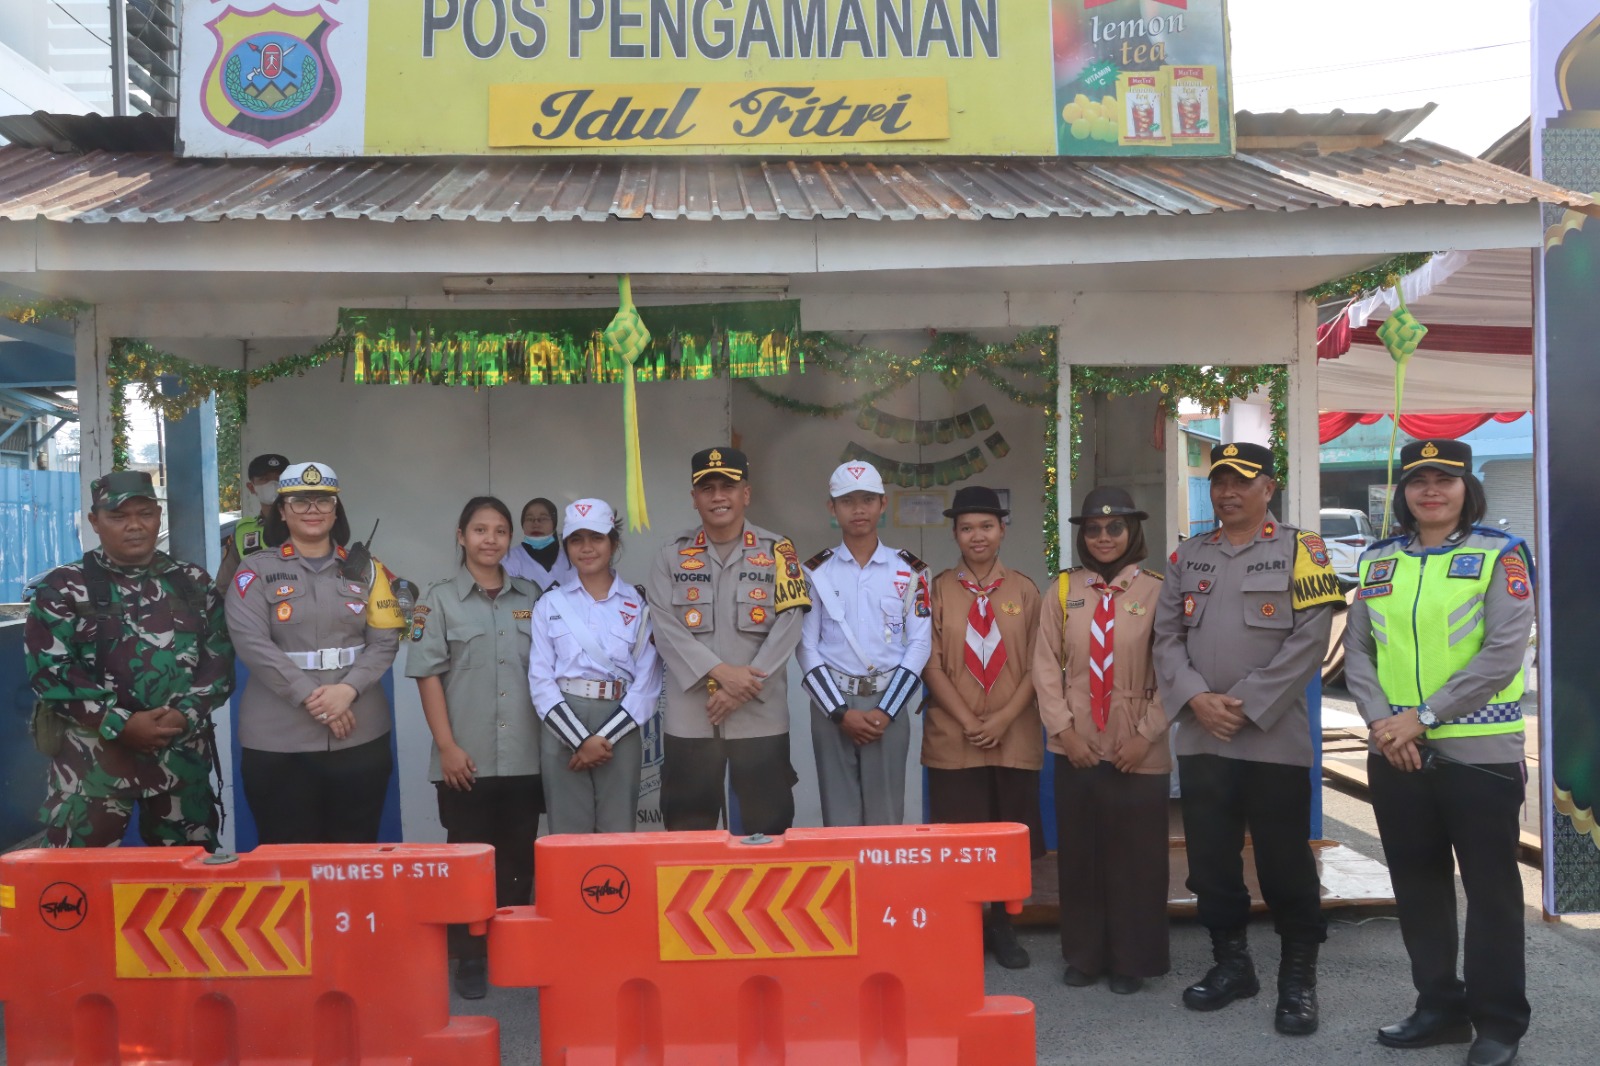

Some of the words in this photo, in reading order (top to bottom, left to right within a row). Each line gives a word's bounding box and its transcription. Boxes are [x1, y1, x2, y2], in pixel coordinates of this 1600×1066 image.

[421, 0, 548, 59] POS
[568, 0, 1001, 59] PENGAMANAN
[1090, 13, 1186, 44] lemon
[1119, 41, 1167, 65] tea
[1085, 65, 1112, 84] VITAMIN
[1099, 78, 1106, 86] C
[532, 87, 702, 141] Idul
[729, 86, 912, 138] Fitri
[1186, 561, 1216, 574] YUDI
[1246, 560, 1286, 574] POLRI
[673, 572, 711, 583] YOGEN
[739, 571, 774, 584] POLRI
[859, 848, 932, 866] POLRES
[311, 863, 384, 881] POLRES
